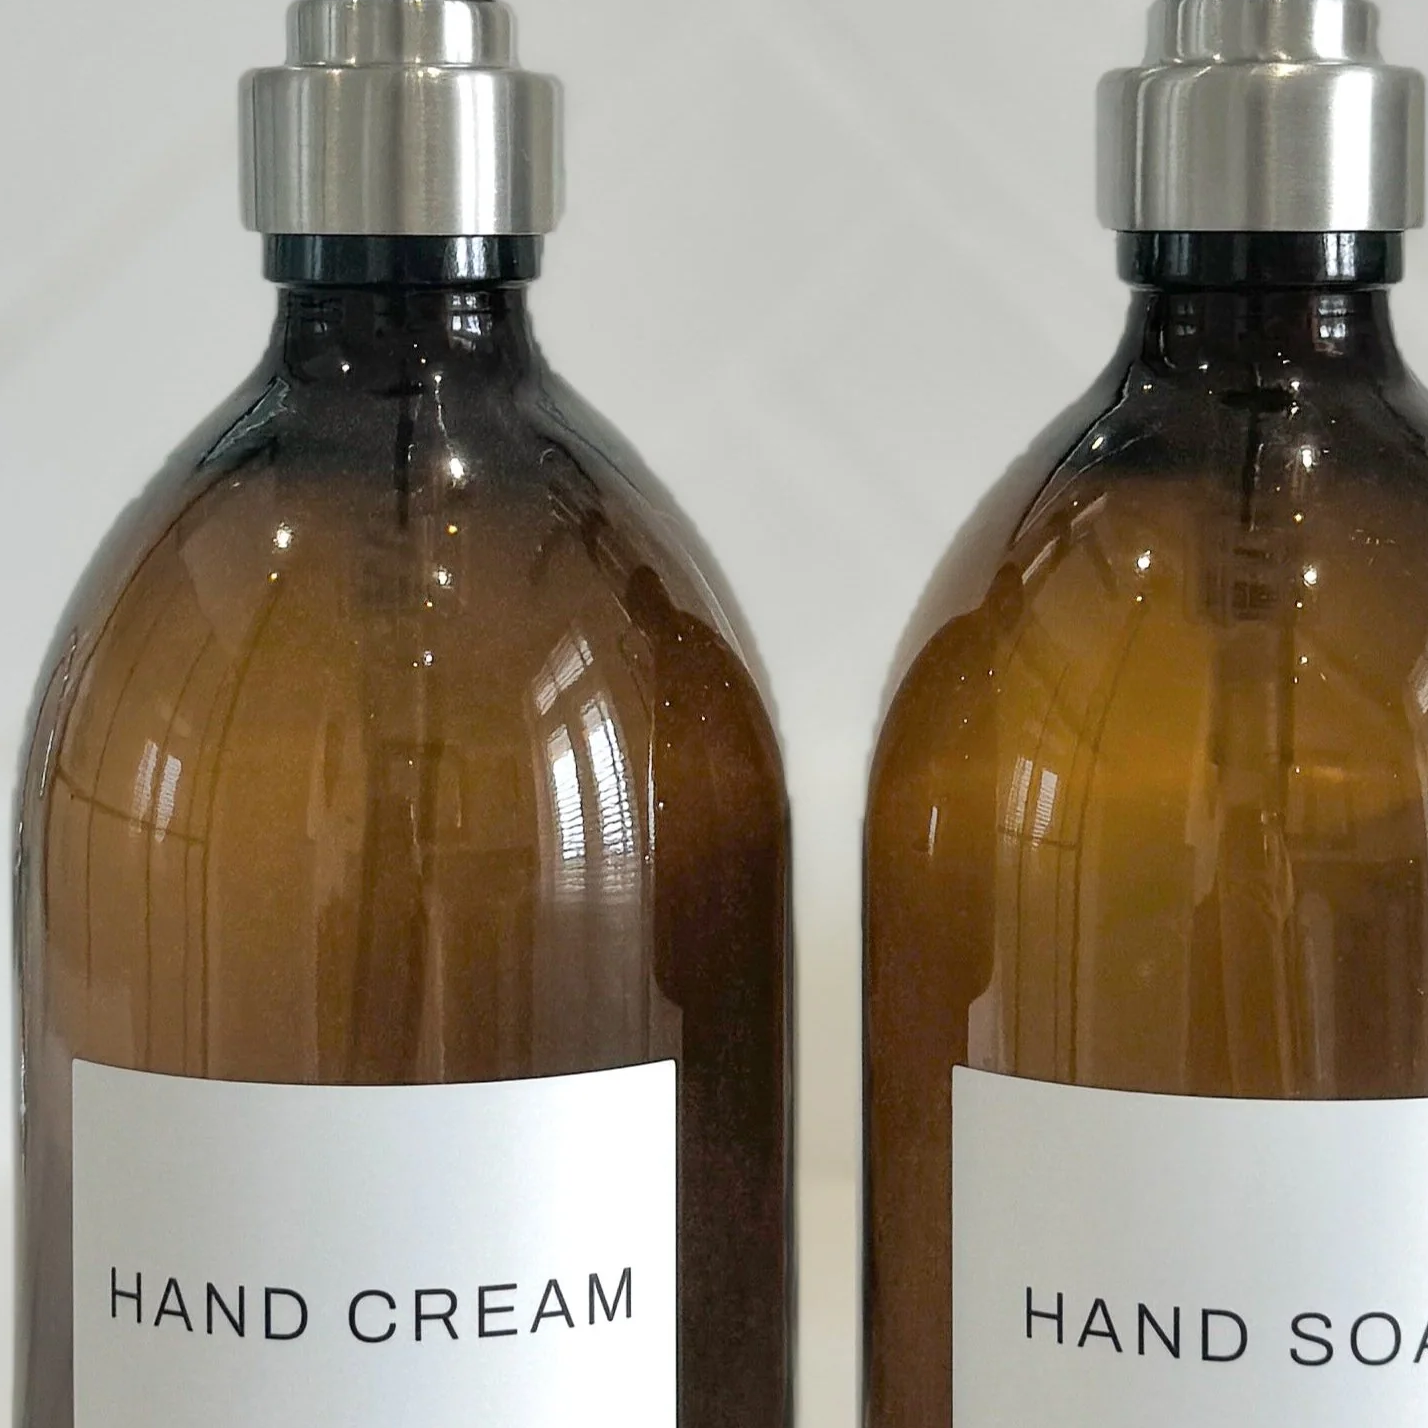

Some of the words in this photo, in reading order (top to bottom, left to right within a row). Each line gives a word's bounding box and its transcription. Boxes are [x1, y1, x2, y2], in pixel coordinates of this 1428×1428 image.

[110, 1266, 310, 1342] HAND
[346, 1266, 633, 1344] CREAM
[1024, 1286, 1249, 1364] HAND
